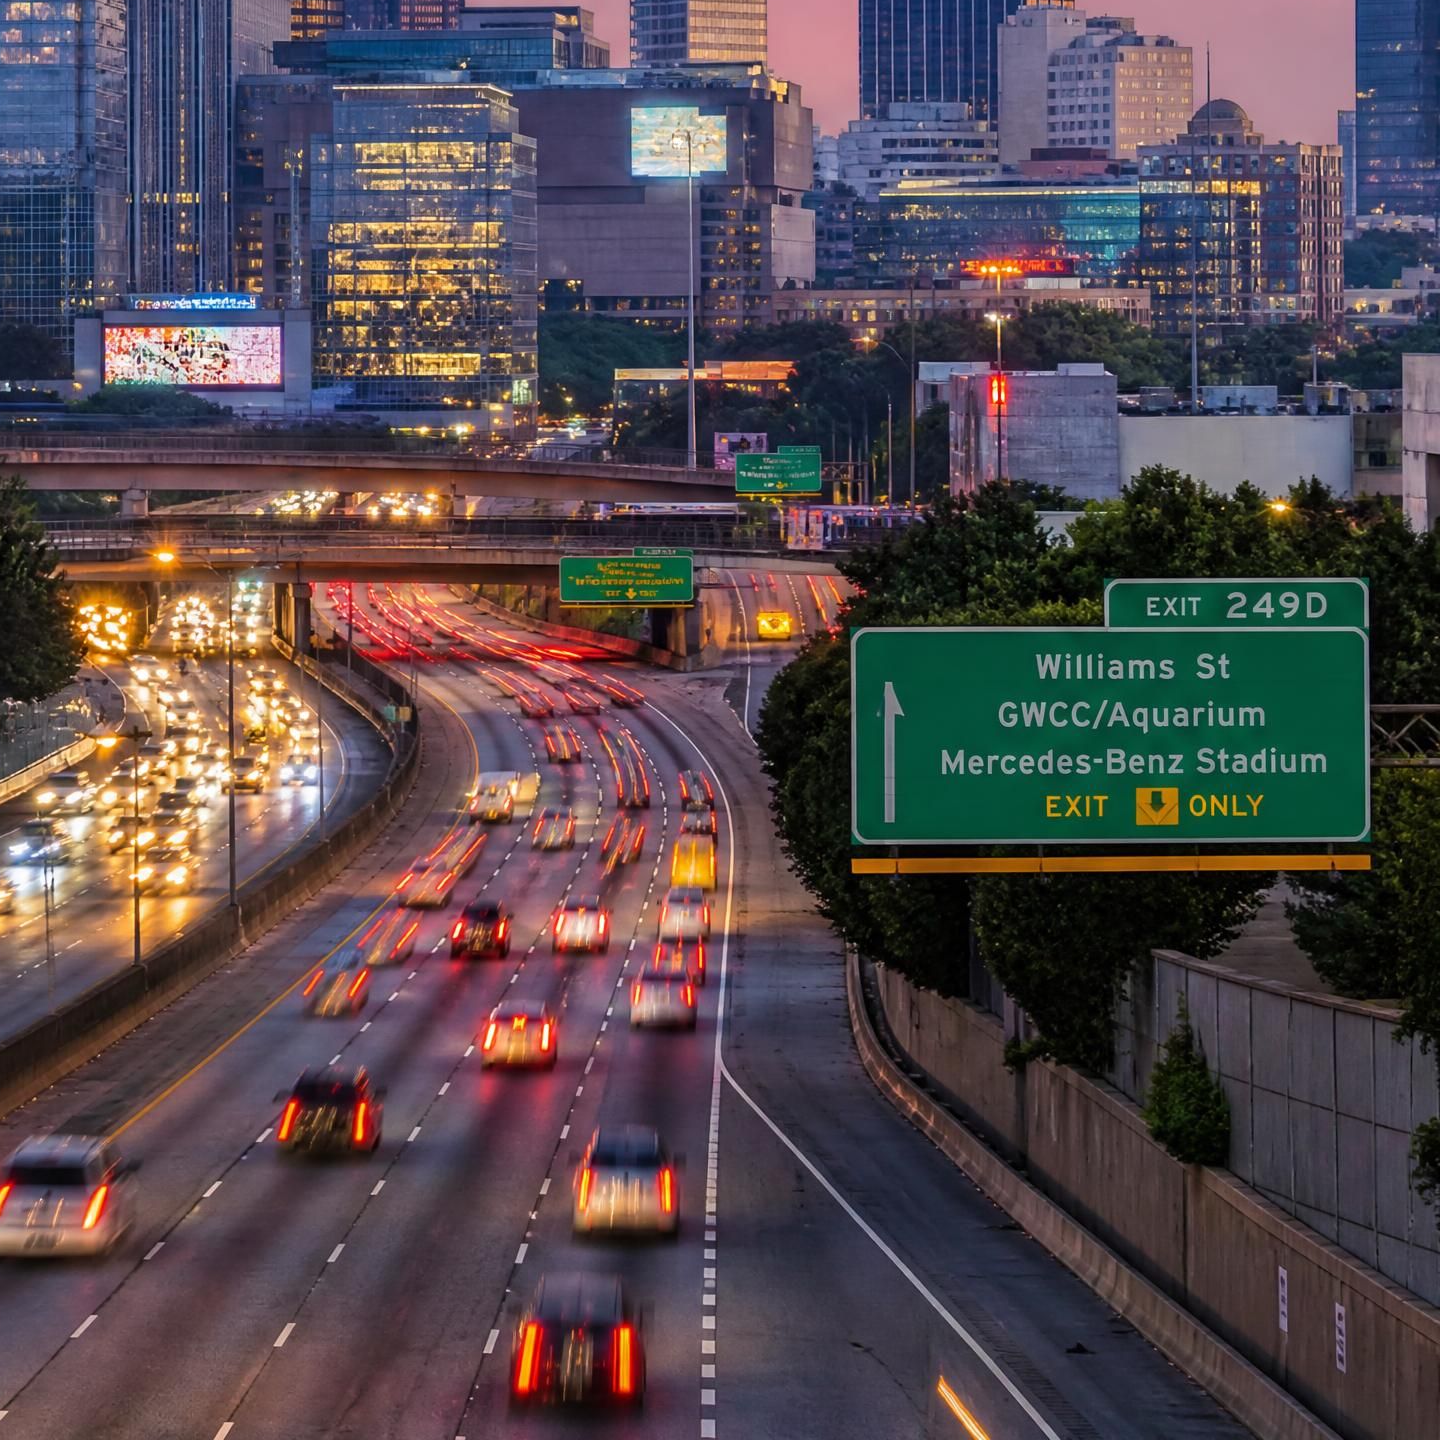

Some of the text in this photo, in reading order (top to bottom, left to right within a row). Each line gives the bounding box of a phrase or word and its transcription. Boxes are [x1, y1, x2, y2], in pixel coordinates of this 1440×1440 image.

[1146, 591, 1328, 618] EXIT 249D
[1036, 653, 1231, 680] Williams St
[998, 700, 1266, 734] GWCC/Aquarium
[941, 748, 1328, 775] Mercedes-Benz Stadium
[1045, 795, 1264, 818] EXIT ONLY
